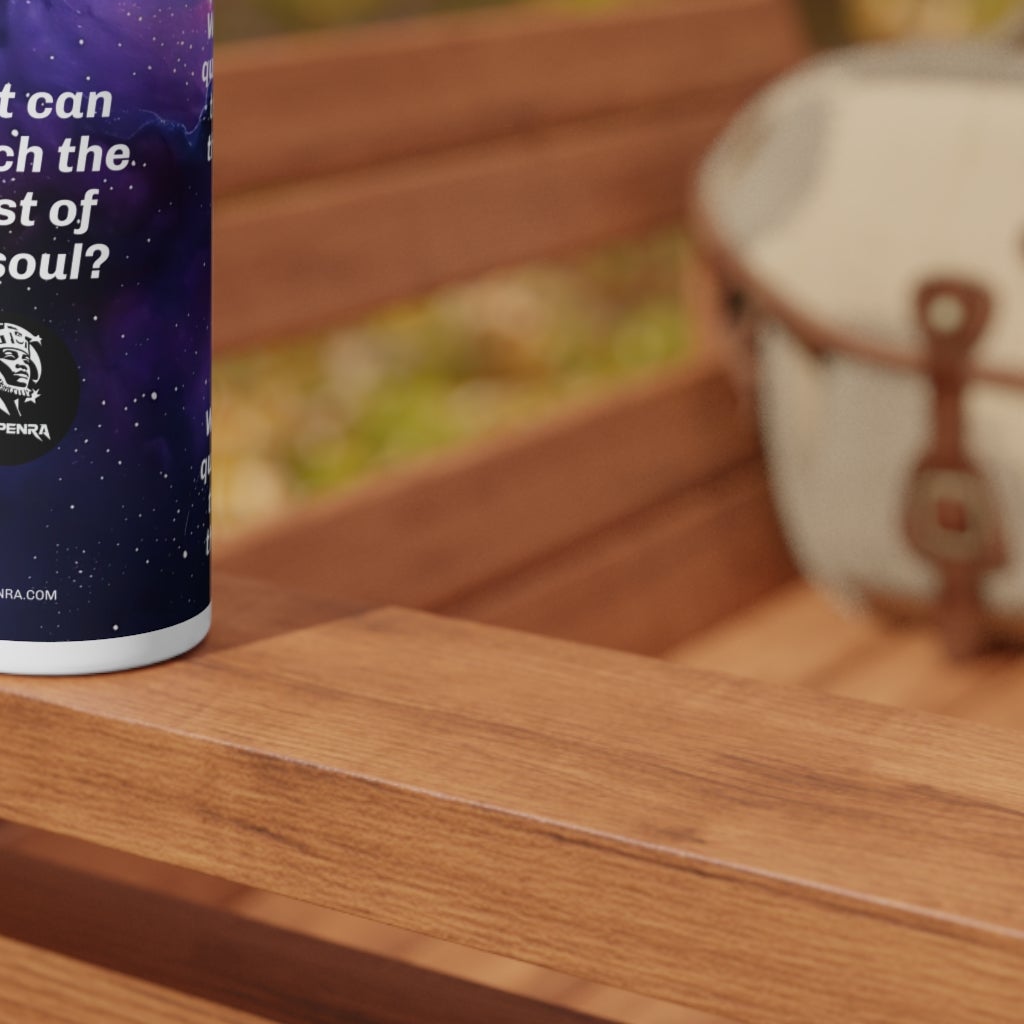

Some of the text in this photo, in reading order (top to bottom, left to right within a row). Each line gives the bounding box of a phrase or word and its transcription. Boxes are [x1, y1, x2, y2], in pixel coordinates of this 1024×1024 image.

[27, 90, 113, 119] can
[57, 135, 131, 173] the
[49, 188, 100, 235] of
